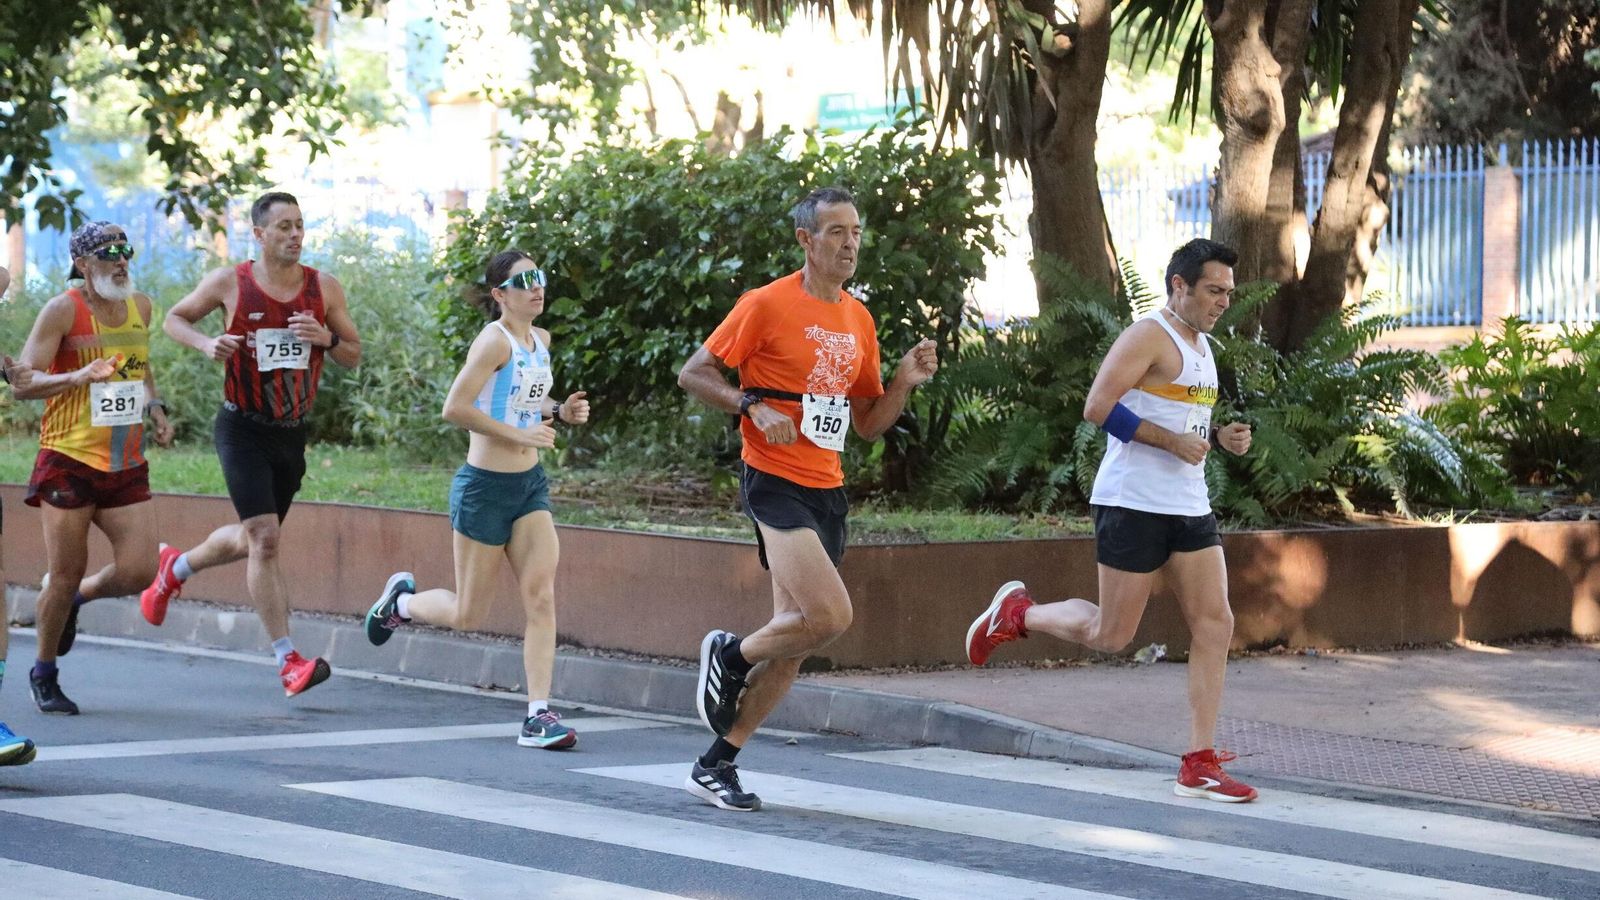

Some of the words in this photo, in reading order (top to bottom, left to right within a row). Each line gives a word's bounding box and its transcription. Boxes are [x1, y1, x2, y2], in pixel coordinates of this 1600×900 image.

[265, 342, 303, 358] 755
[529, 383, 544, 398] 65
[100, 396, 136, 412] 281
[811, 414, 842, 434] 150
